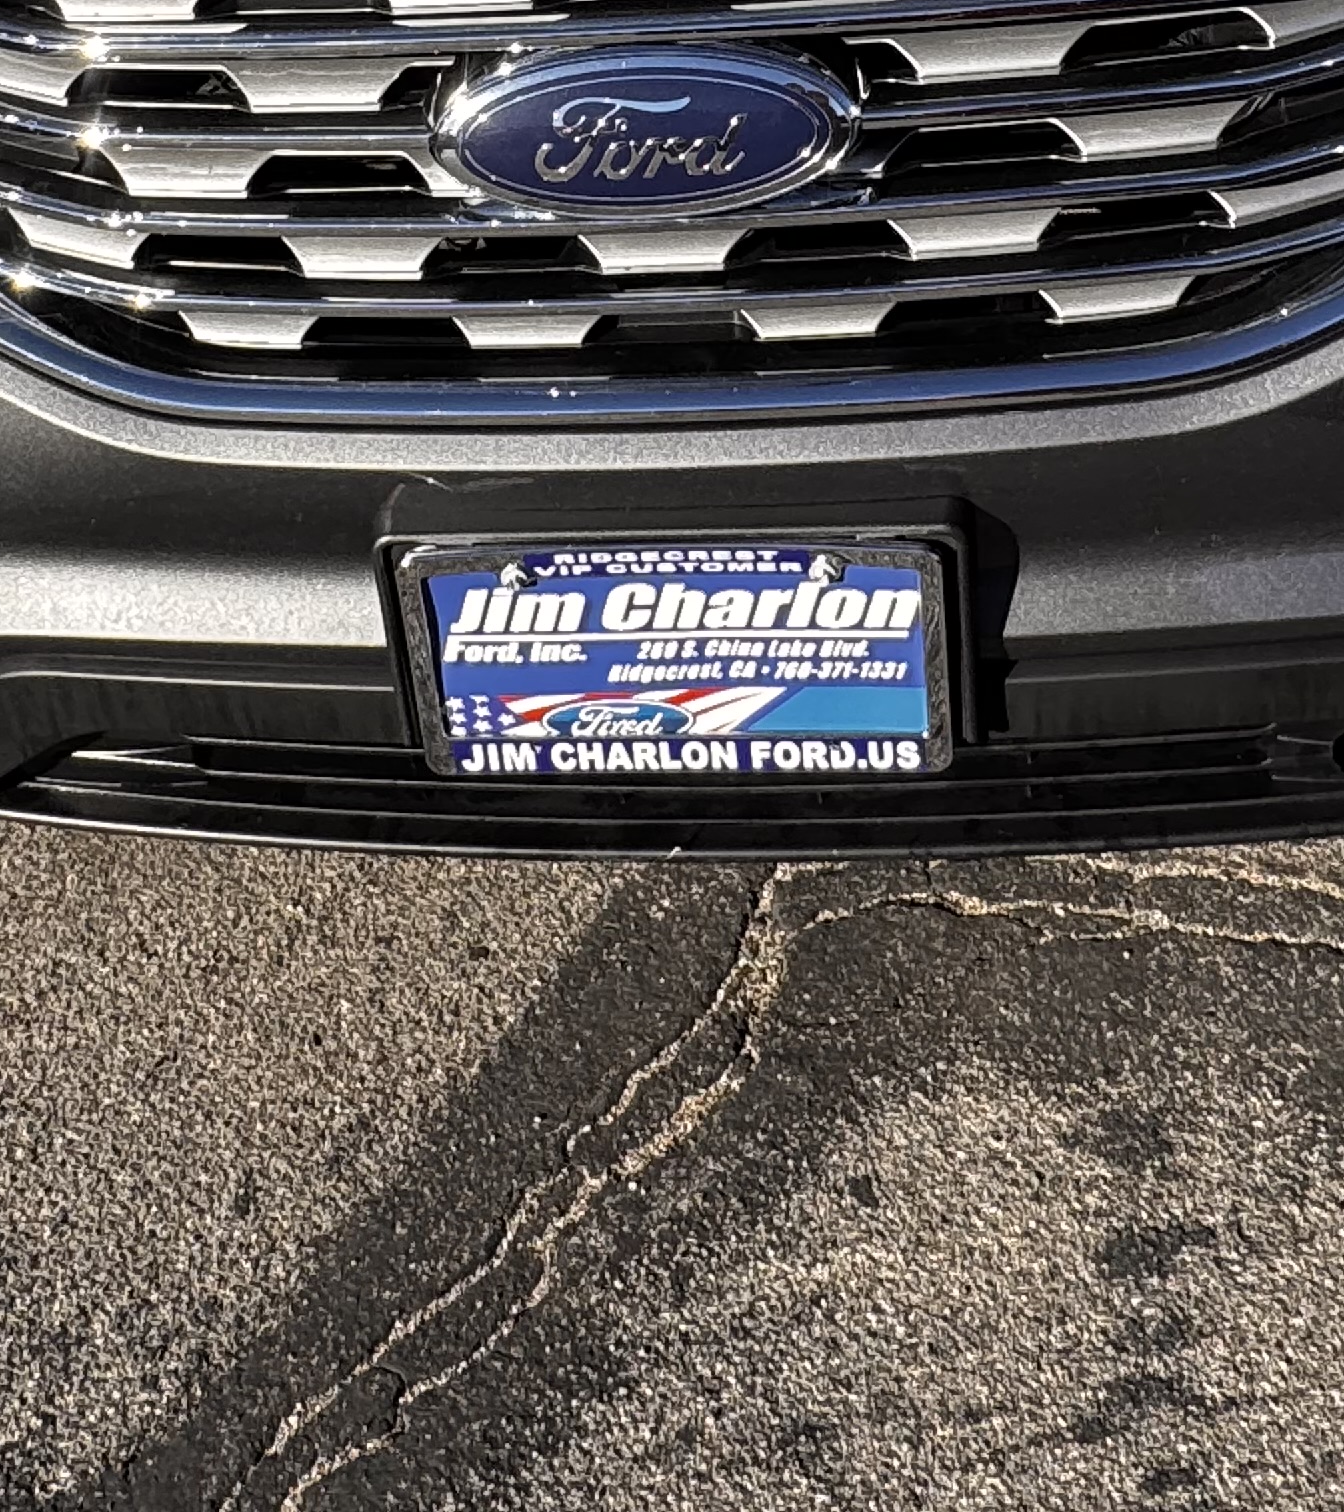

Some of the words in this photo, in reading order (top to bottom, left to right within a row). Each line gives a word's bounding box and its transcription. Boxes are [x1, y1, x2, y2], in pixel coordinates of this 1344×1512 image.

[535, 96, 747, 181] Ford
[533, 564, 593, 577] VIP
[606, 561, 803, 575] CUSTOMER
[552, 550, 779, 565] RIDGECREST
[450, 587, 586, 633] Jim
[601, 581, 922, 631] Charlon
[443, 636, 524, 664] Ford,
[529, 641, 588, 663] Inc.
[728, 659, 757, 679] CA
[571, 706, 664, 736] Ford
[462, 742, 536, 772] JIM
[550, 741, 739, 771] CHARLON
[752, 740, 922, 771] FORD.US
